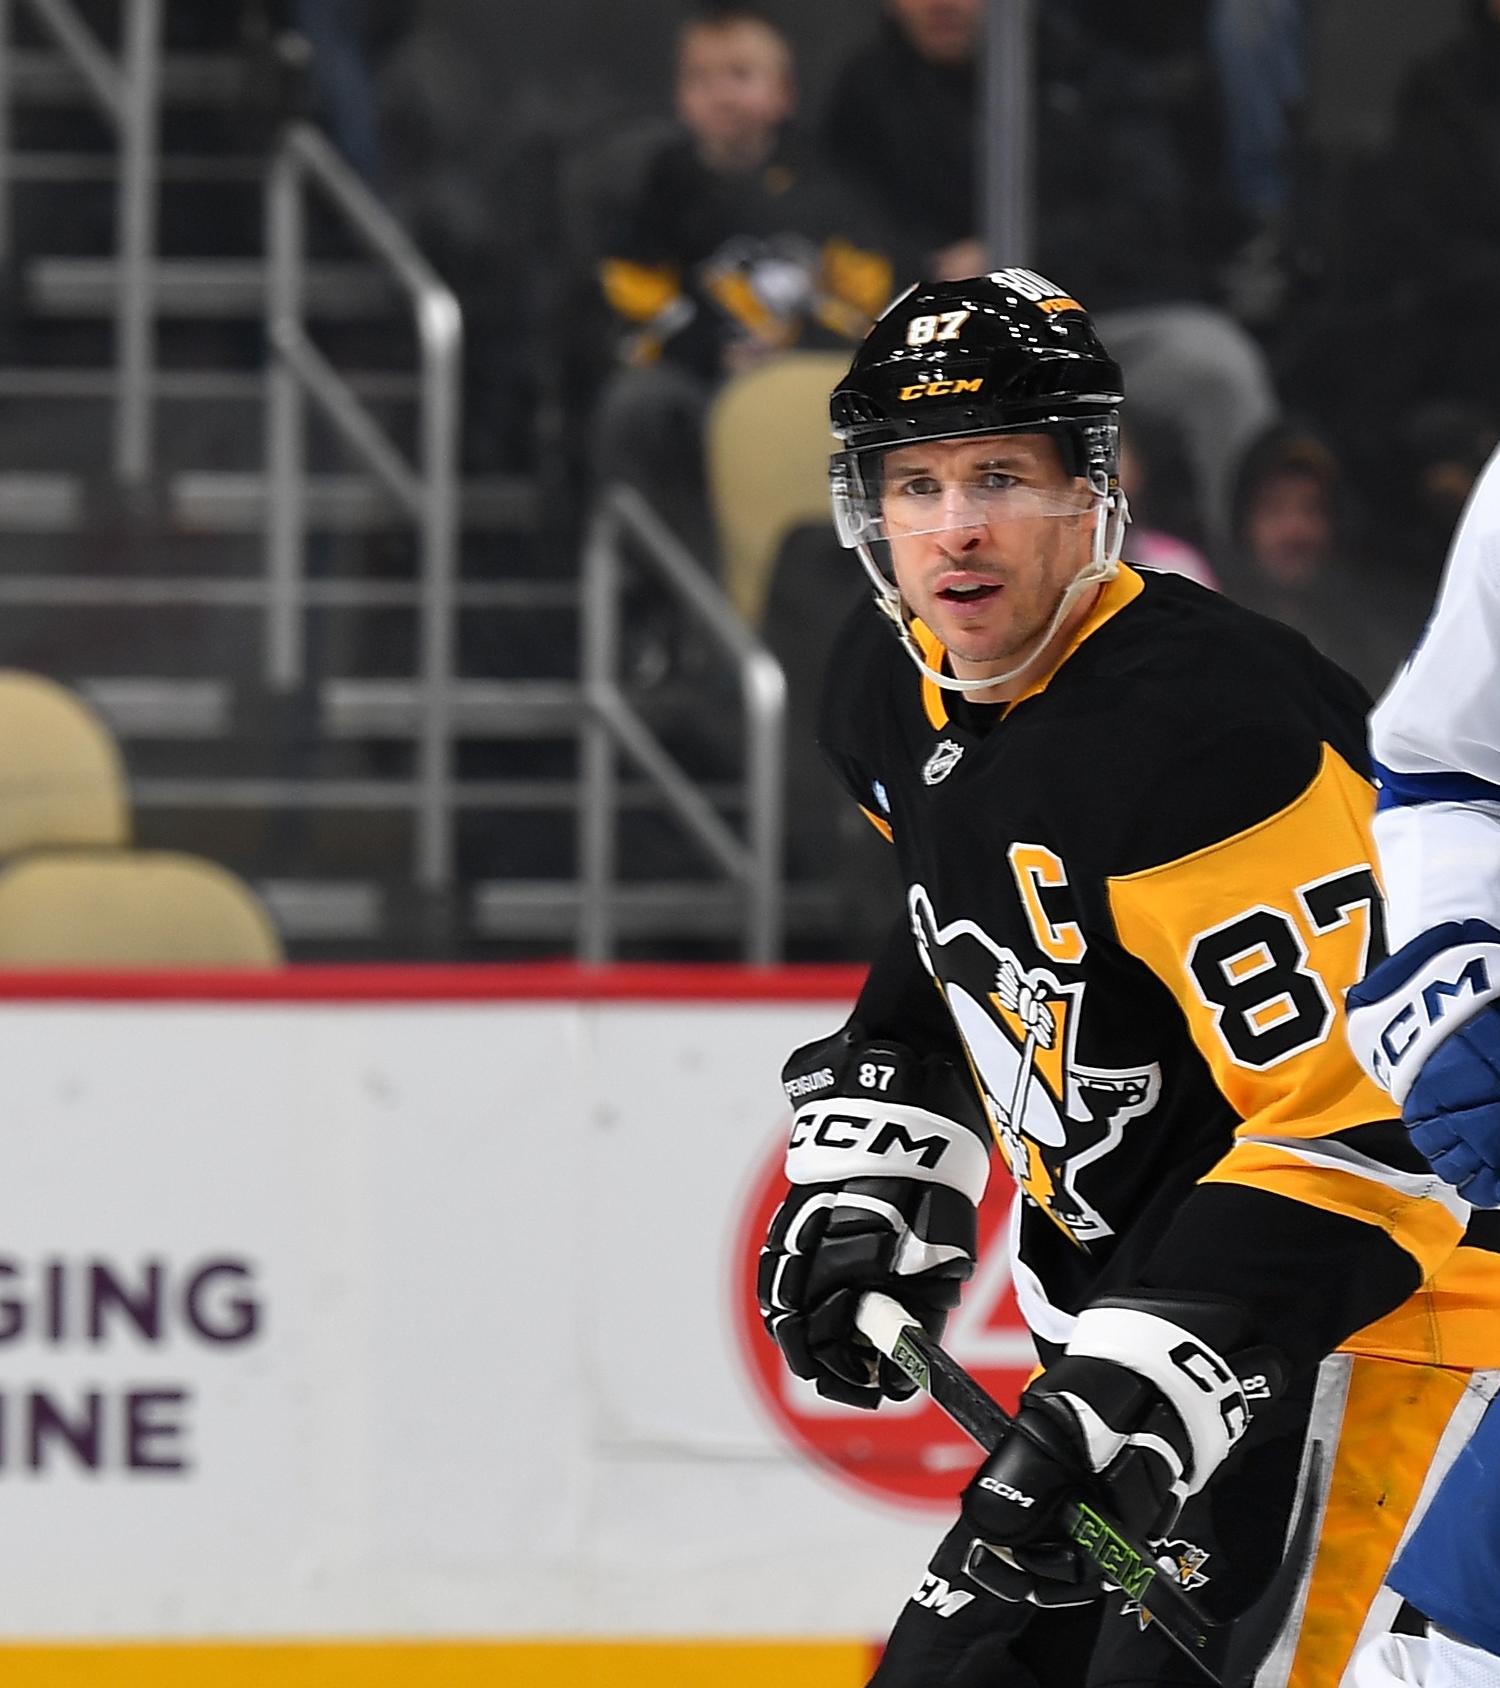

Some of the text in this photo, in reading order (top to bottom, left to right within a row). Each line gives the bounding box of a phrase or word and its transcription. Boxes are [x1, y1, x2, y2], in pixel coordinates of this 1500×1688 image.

[906, 310, 970, 345] 87
[899, 378, 984, 401] CCM
[1007, 842, 1088, 964] C
[1184, 864, 1392, 1072] 87
[859, 1063, 896, 1091] 87
[790, 1113, 951, 1170] CCM
[895, 1344, 927, 1380] CCM
[1242, 1375, 1271, 1399] 87
[978, 1476, 1036, 1509] CCM
[1072, 1503, 1156, 1600] CCM
